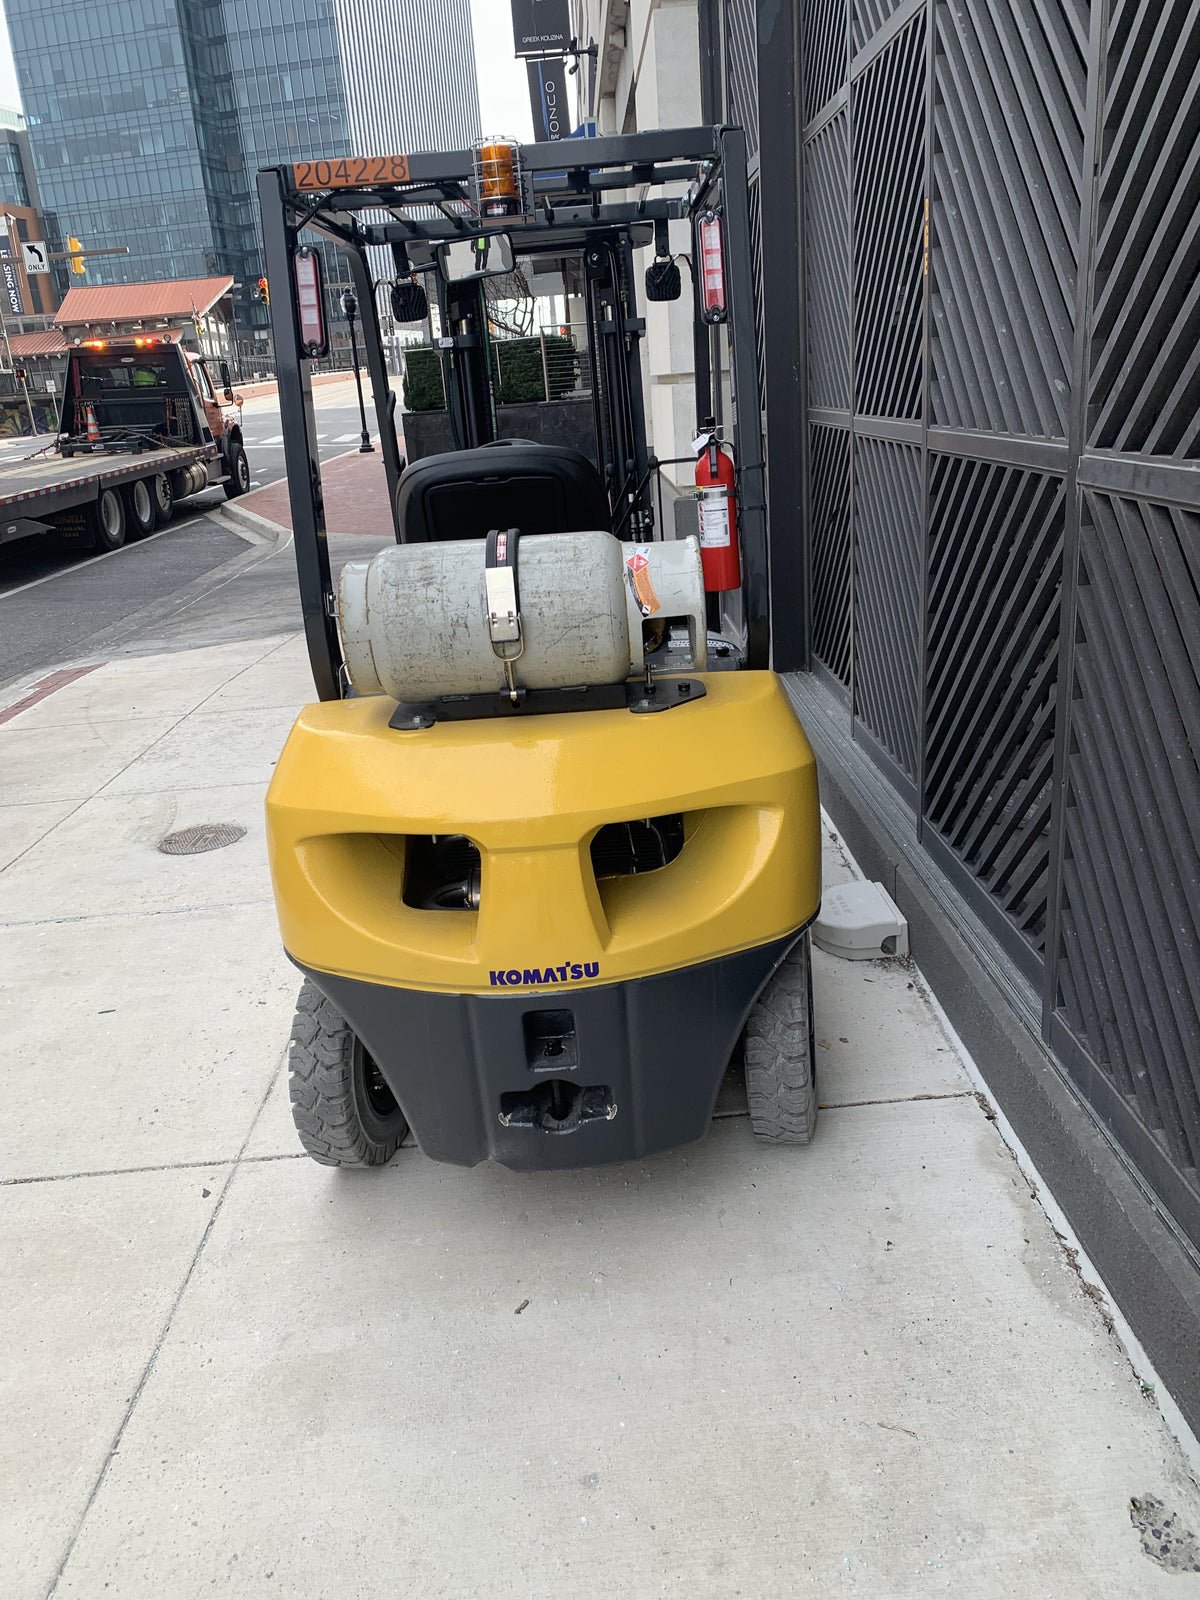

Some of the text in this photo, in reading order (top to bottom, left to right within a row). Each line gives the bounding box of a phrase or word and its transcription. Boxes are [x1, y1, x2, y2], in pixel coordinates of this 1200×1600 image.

[545, 81, 560, 132] OUZO
[297, 156, 406, 187] 204228
[0, 249, 20, 313] LESING NOW
[489, 961, 599, 986] KOMATSU
